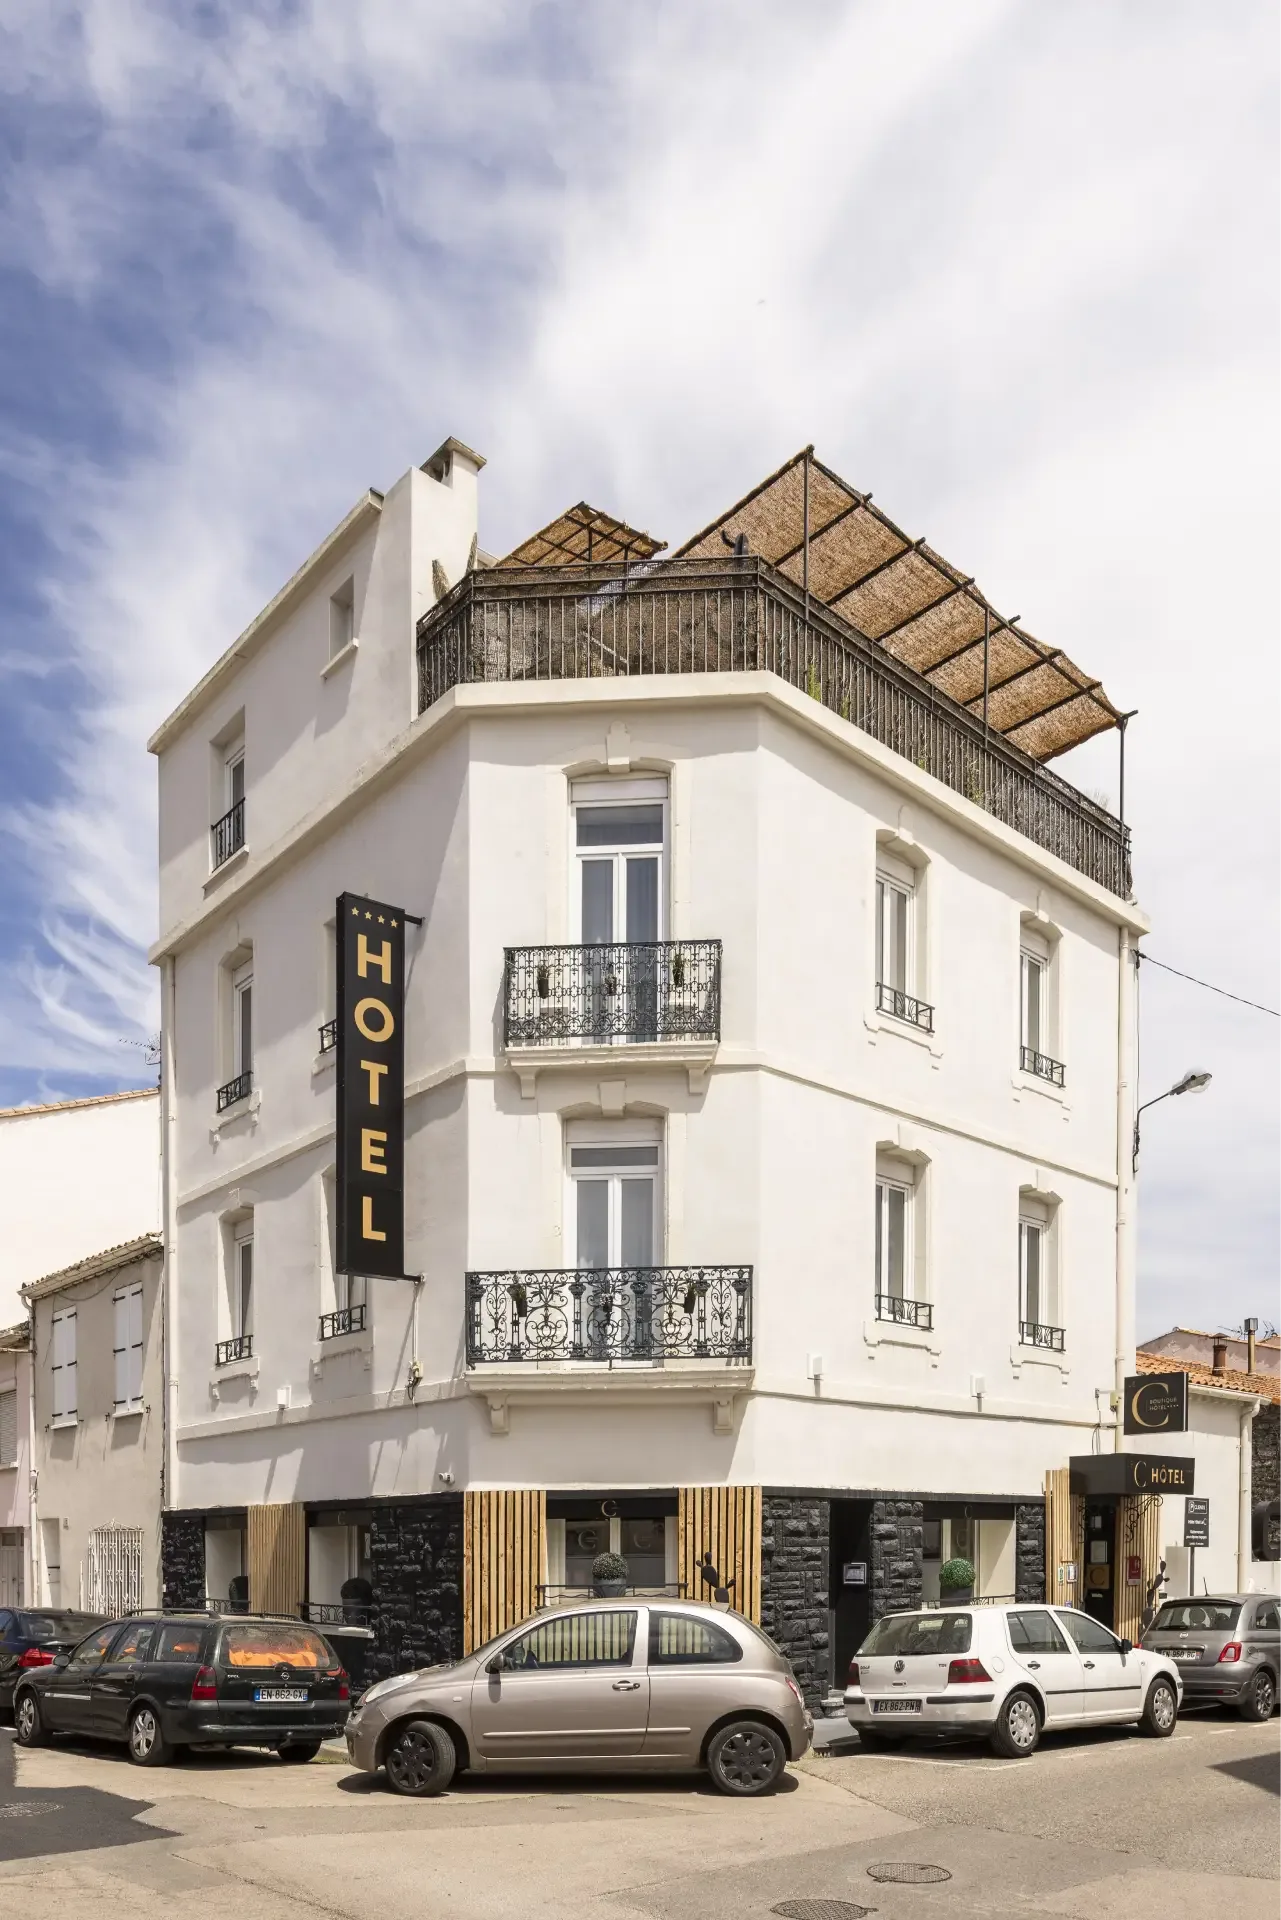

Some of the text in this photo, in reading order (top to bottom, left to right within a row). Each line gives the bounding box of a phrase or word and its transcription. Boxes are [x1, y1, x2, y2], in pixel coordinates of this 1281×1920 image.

[354, 933, 395, 1242] HOTEL
[1132, 1382, 1169, 1428] C
[1134, 1460, 1185, 1488] C HÔTEL
